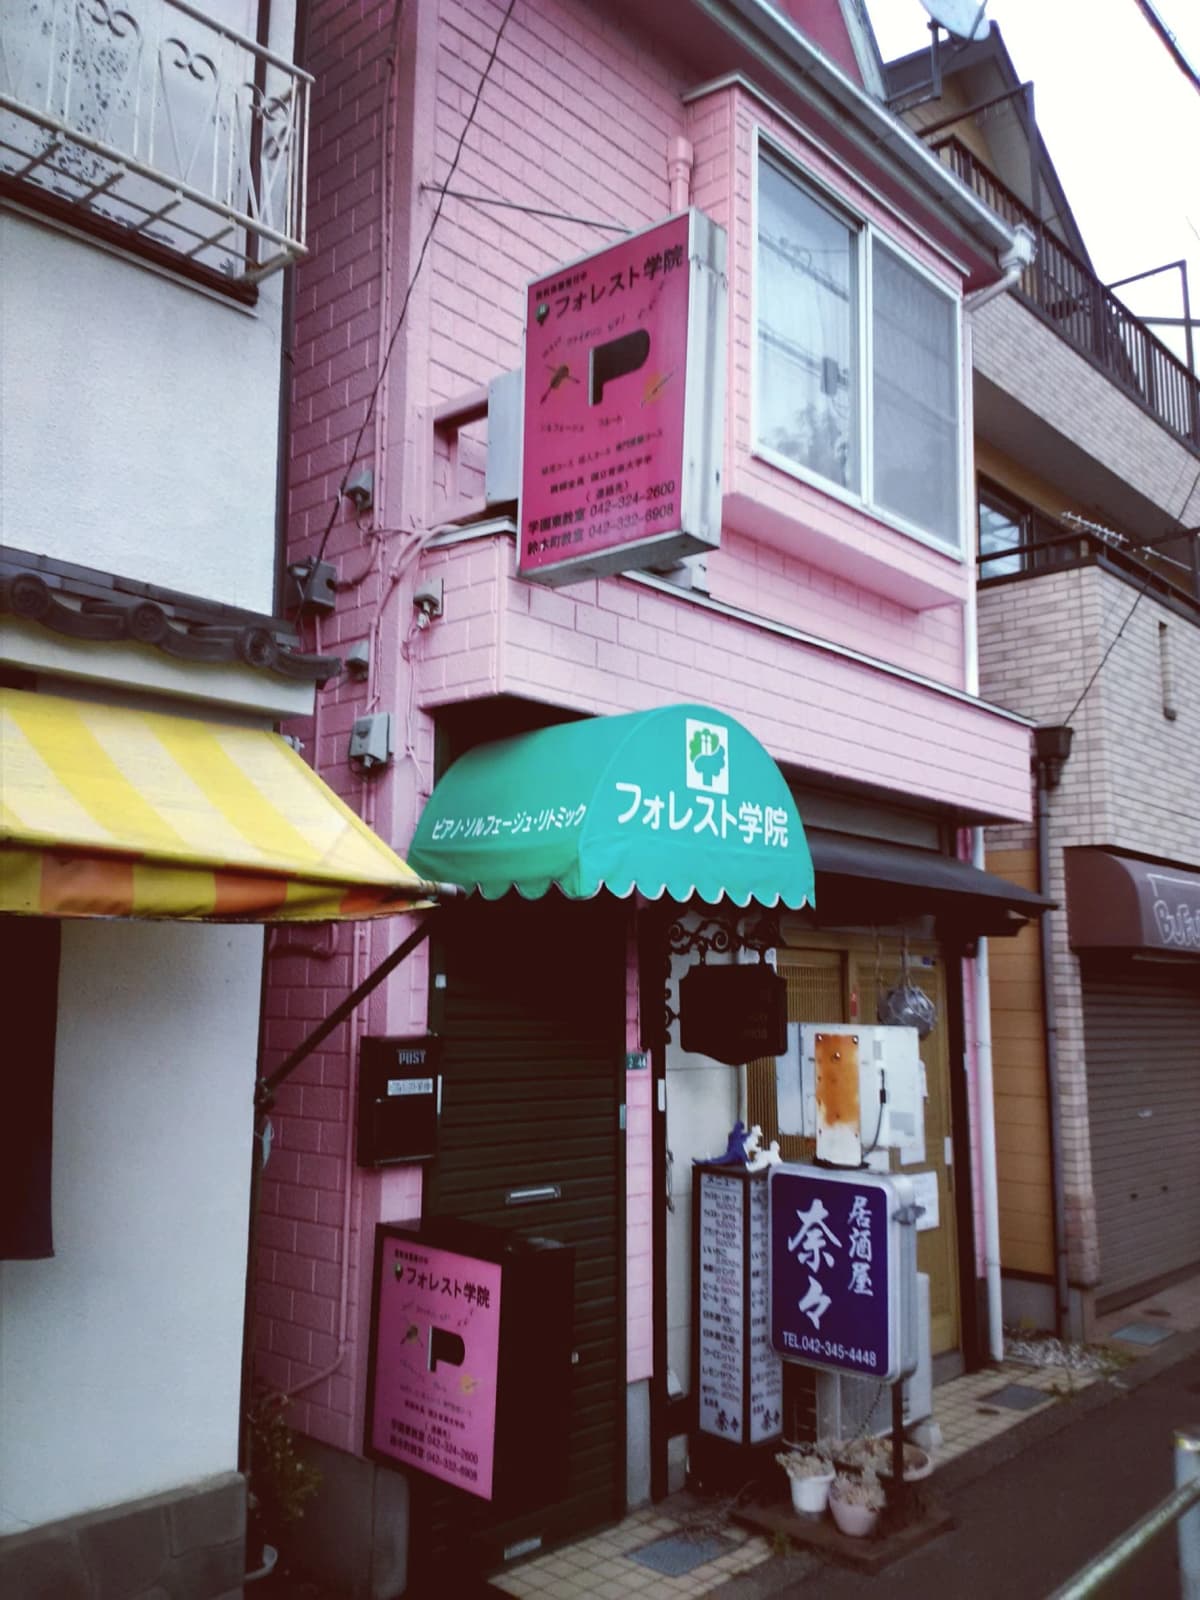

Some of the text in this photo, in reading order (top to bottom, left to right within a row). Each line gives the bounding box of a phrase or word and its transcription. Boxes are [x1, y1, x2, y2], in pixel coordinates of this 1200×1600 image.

[555, 244, 684, 319] フォレスト学院
[615, 781, 789, 848] フォレスト学院
[398, 1049, 426, 1065] POST
[787, 1198, 843, 1330] 奈々
[848, 1195, 874, 1296] 居酒屋
[407, 1266, 491, 1309] フォレスト学院
[715, 1409, 739, 1432] 奈々
